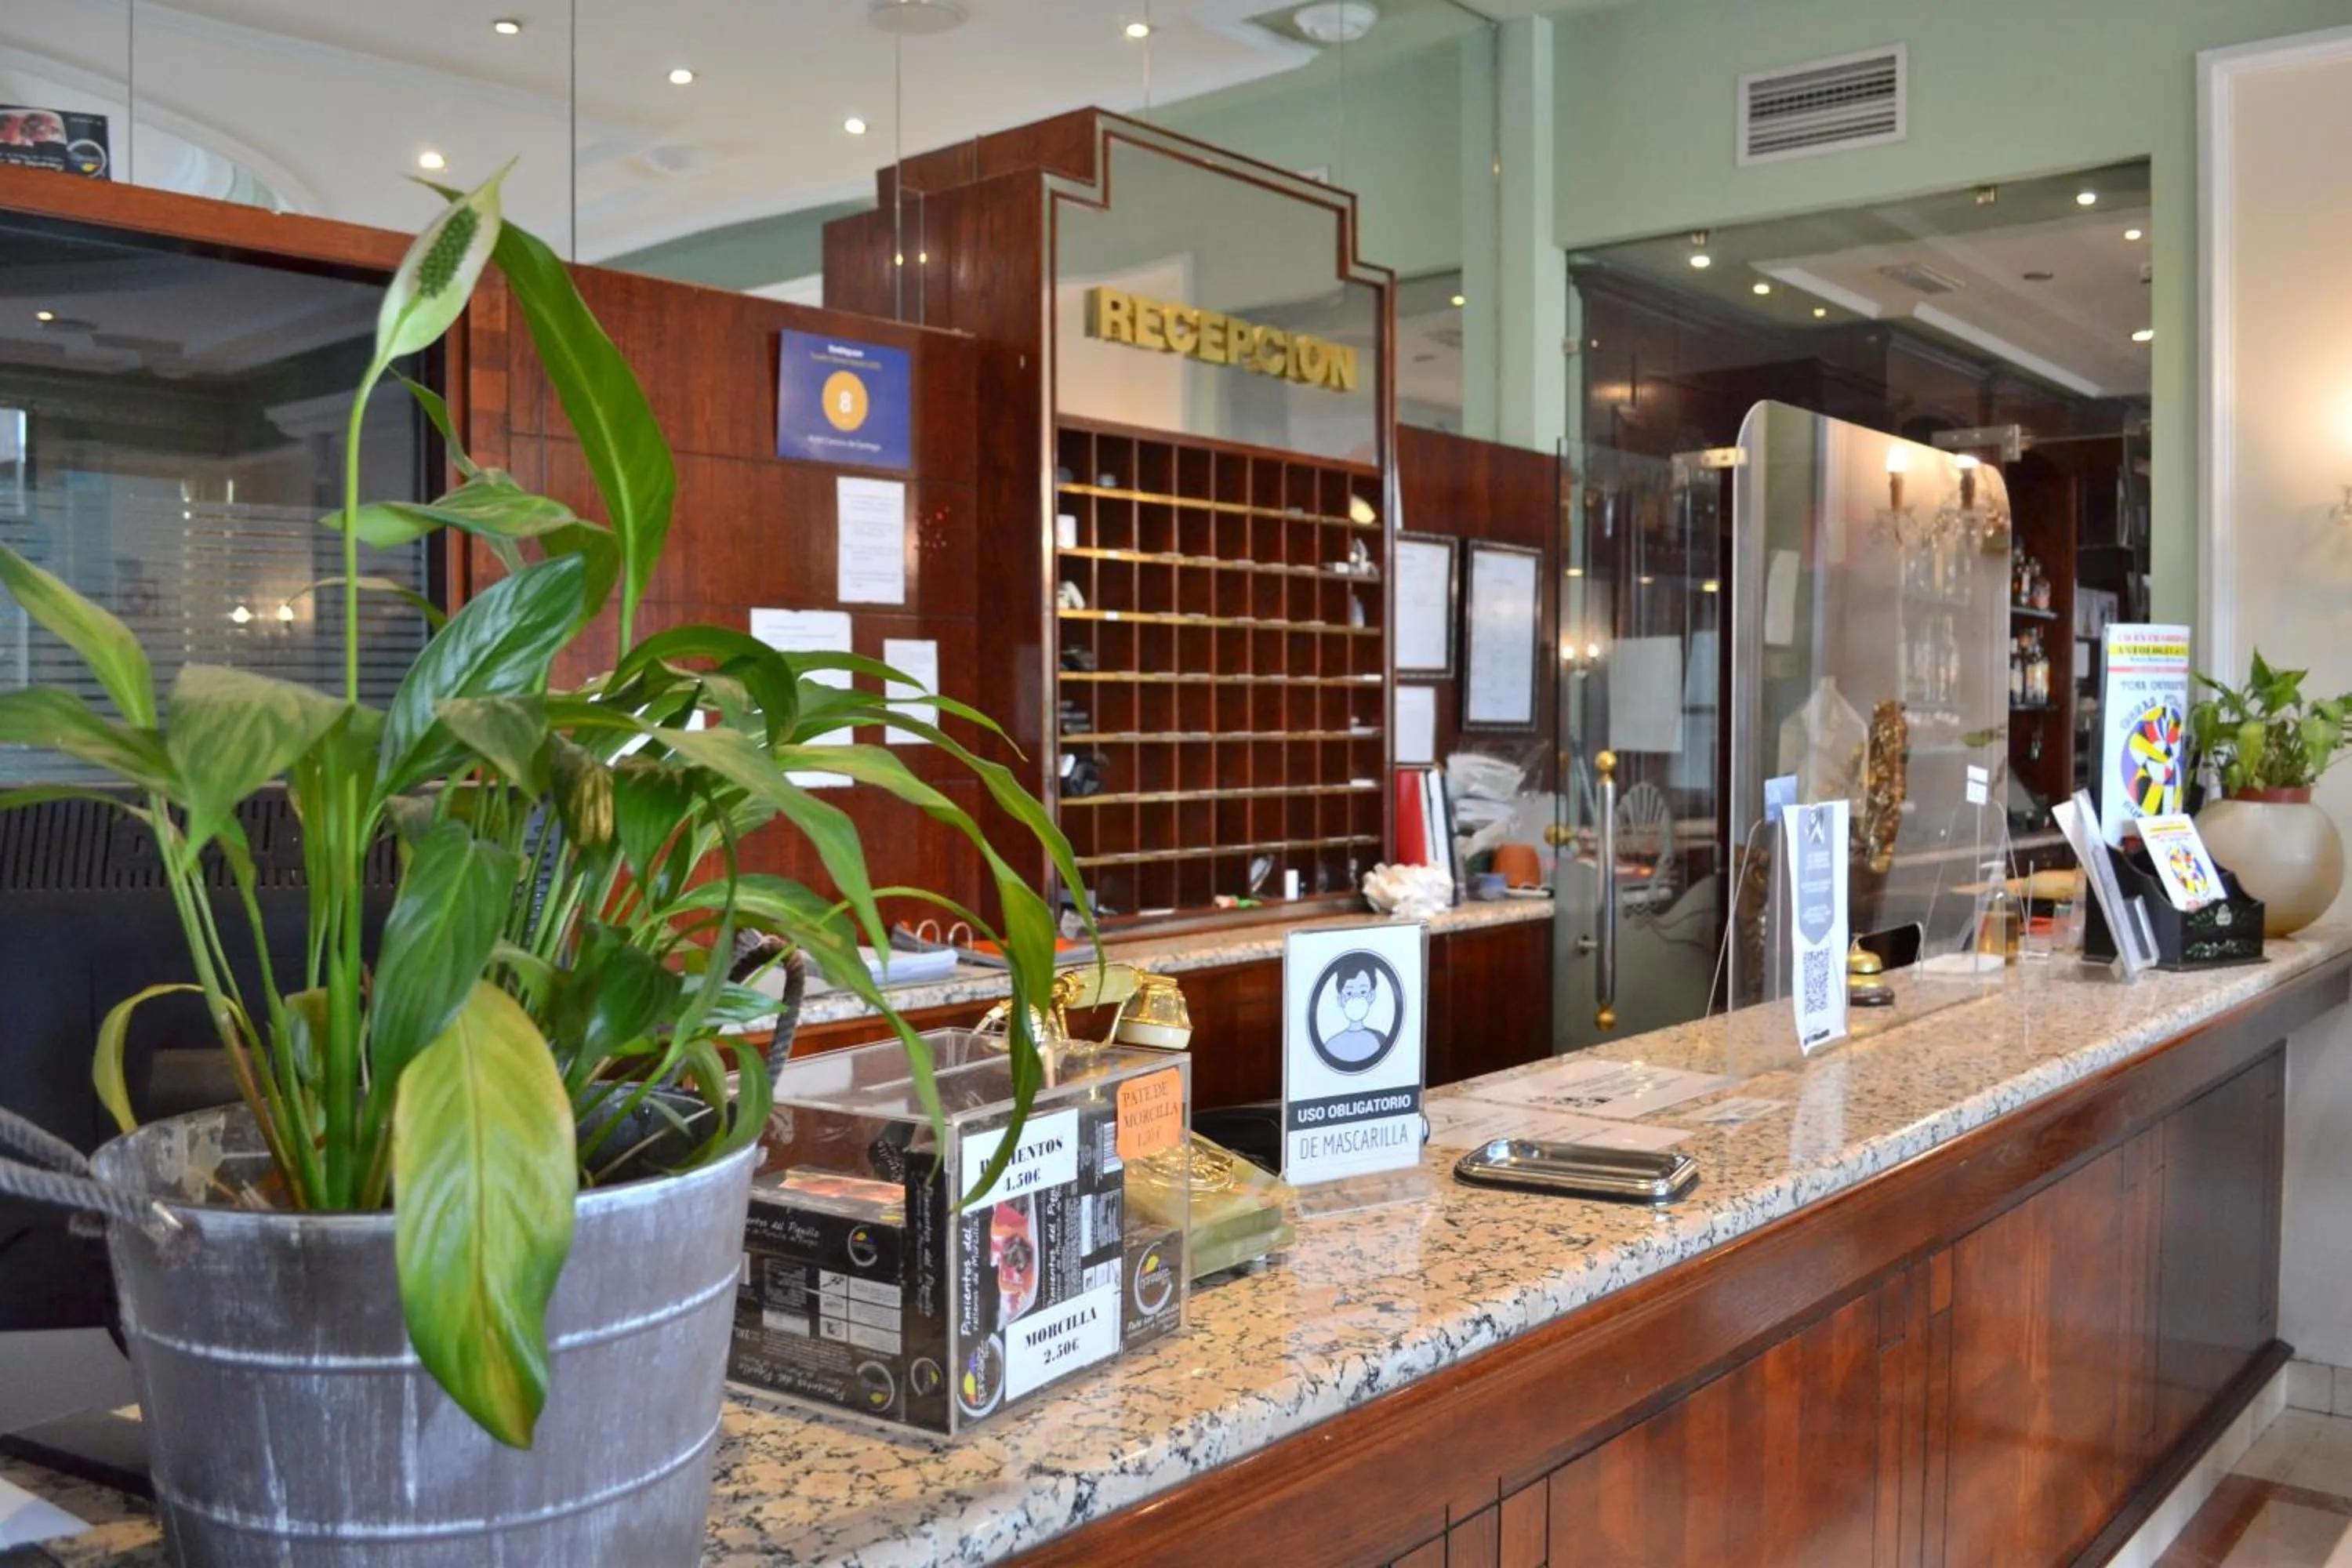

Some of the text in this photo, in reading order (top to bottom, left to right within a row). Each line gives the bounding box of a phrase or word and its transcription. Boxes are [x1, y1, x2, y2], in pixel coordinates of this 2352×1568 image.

[1085, 285, 1358, 392] RECEPCION
[1152, 1081, 1168, 1098] DE
[1123, 1101, 1179, 1128] MORCILLA
[1298, 1094, 1411, 1123] USO OBLIGATORIO
[1299, 1136, 1318, 1160] DE
[1323, 1123, 1409, 1156] MASCARILLA
[960, 1228, 972, 1251] del
[960, 1258, 972, 1337] Pimientos
[1024, 1306, 1098, 1350] MORCILLA
[1043, 1338, 1080, 1367] 2.50€
